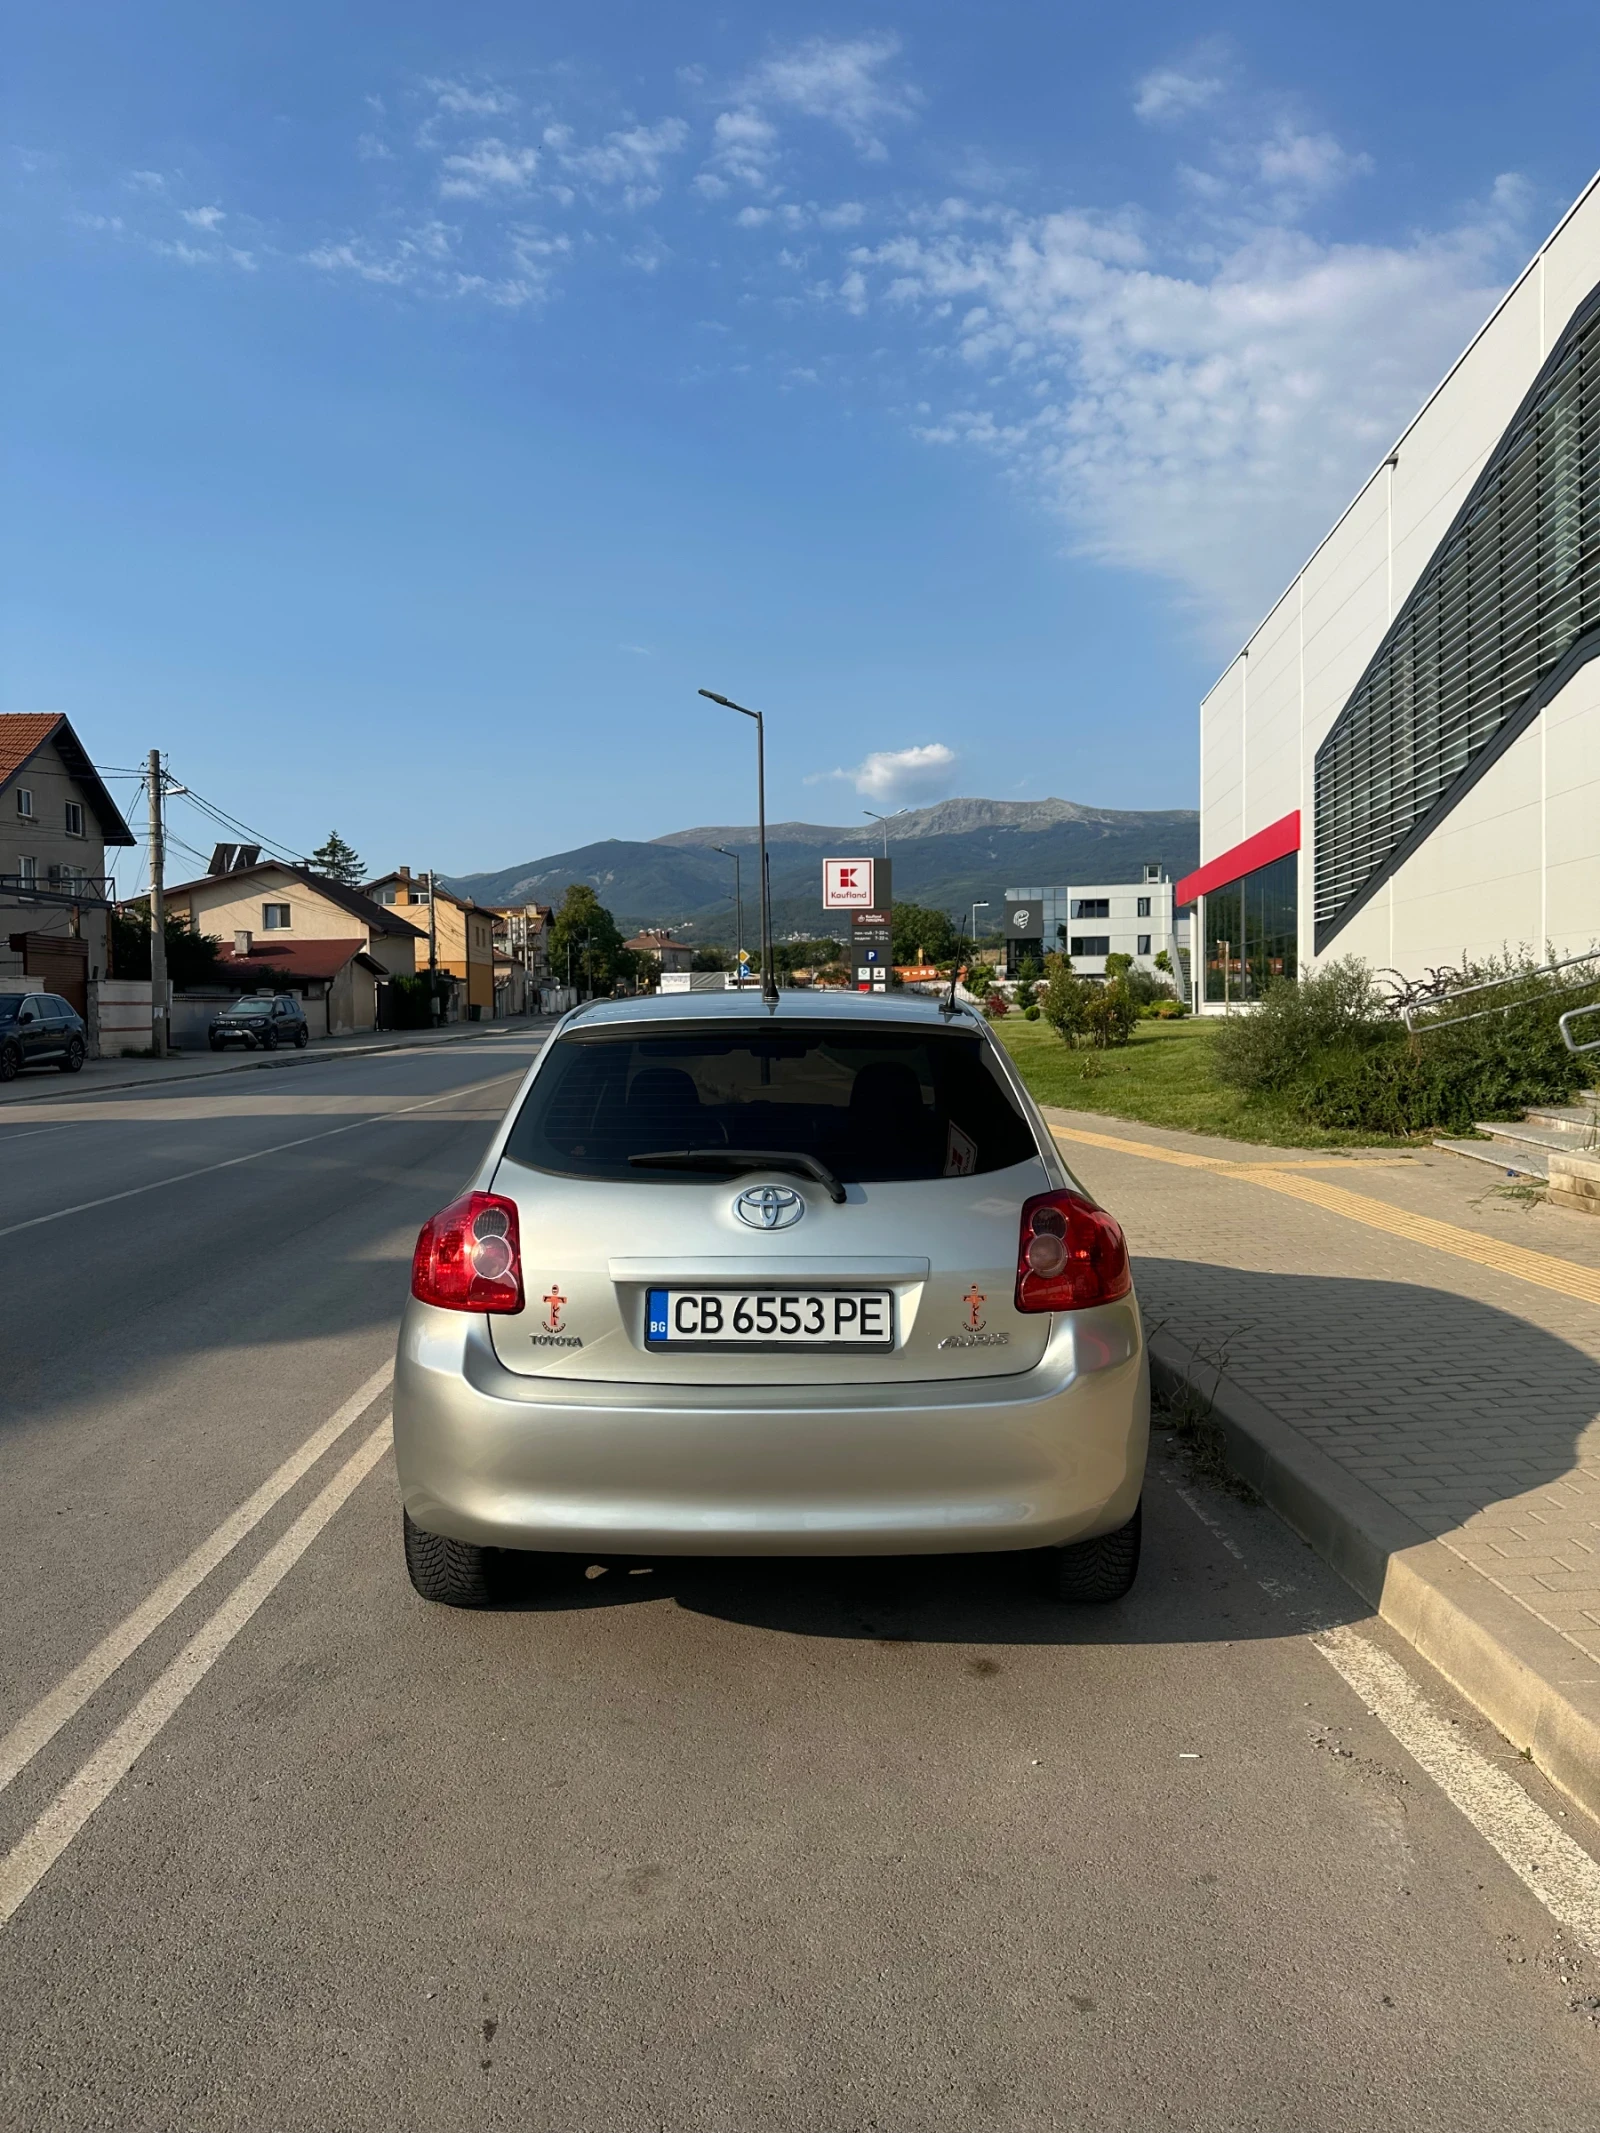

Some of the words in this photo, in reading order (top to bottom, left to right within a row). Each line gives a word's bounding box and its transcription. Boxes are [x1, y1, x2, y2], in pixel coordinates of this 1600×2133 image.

[831, 891, 867, 899] Kaufland
[868, 951, 875, 960] P
[650, 1322, 666, 1333] BG
[675, 1297, 724, 1334] CB
[733, 1297, 825, 1335] 6553
[834, 1298, 884, 1336] PE
[529, 1333, 583, 1348] TOYOTA
